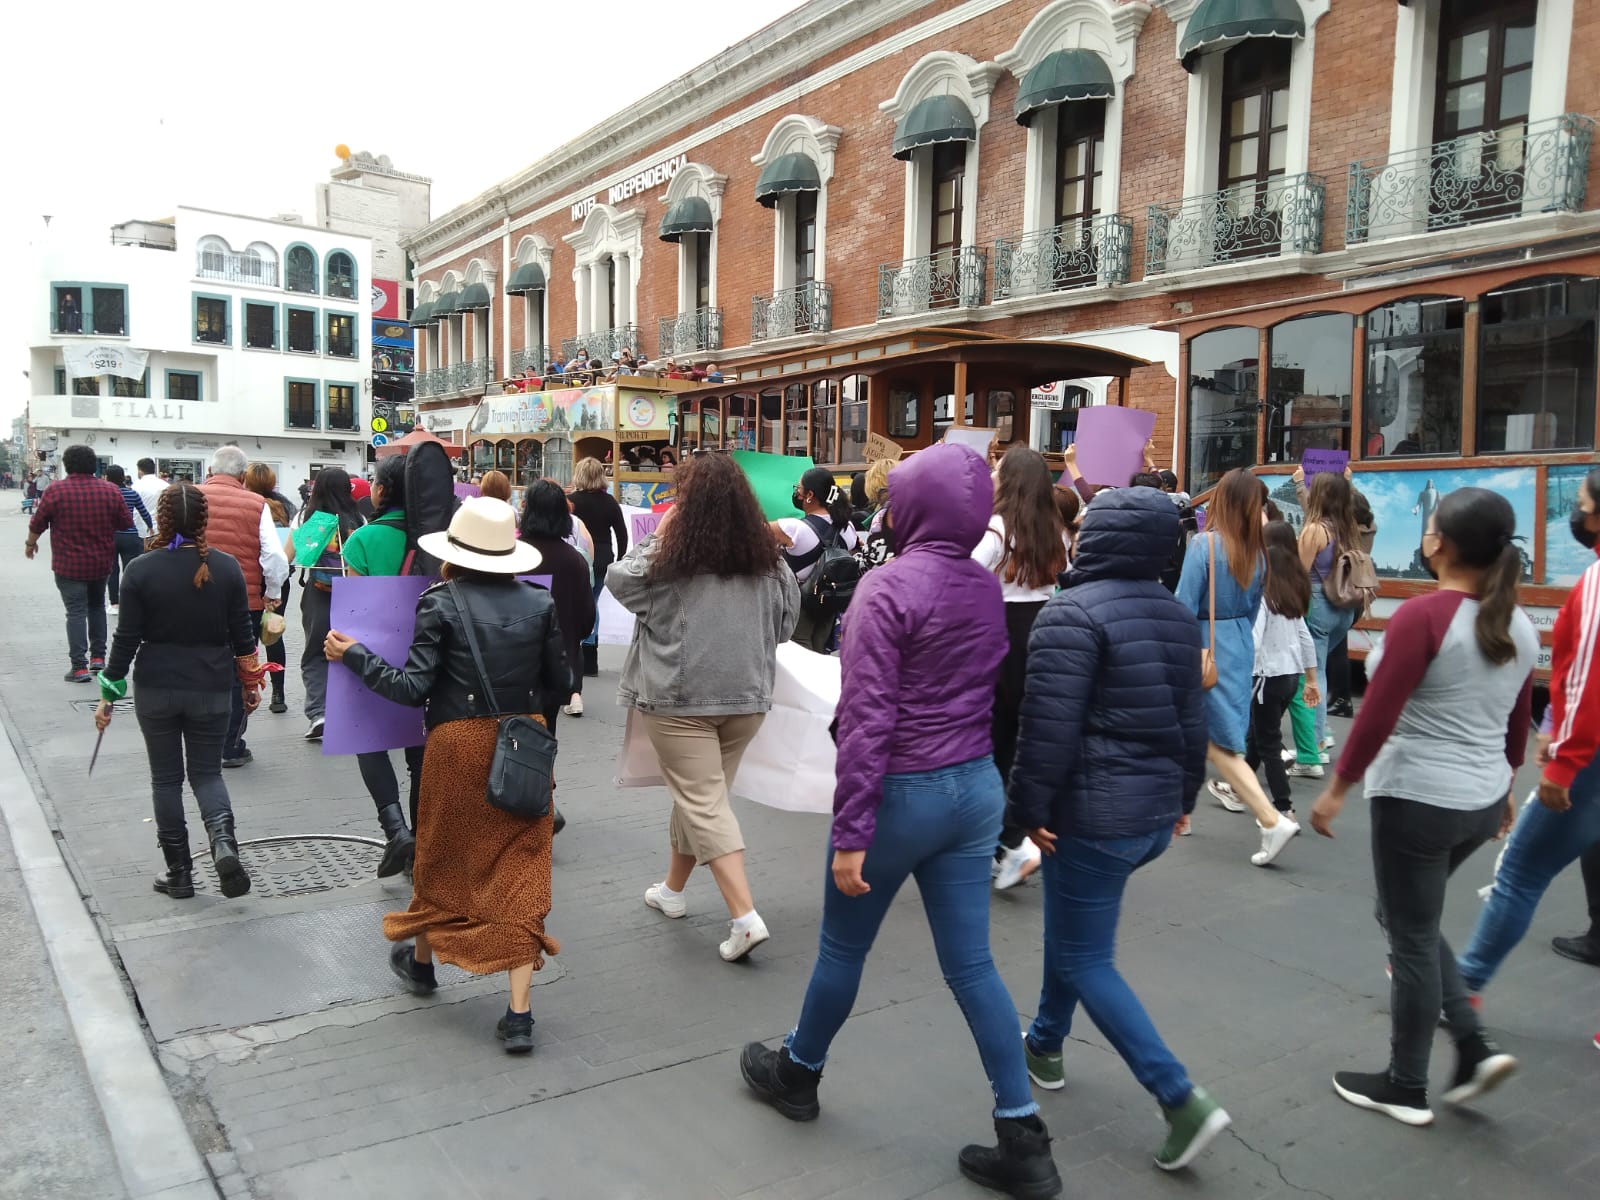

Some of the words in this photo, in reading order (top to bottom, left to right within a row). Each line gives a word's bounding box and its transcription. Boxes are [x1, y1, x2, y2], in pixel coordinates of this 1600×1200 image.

[357, 163, 385, 173] COMIDA
[608, 154, 687, 205] INDEPENDENCIA
[112, 402, 184, 420] TLALI
